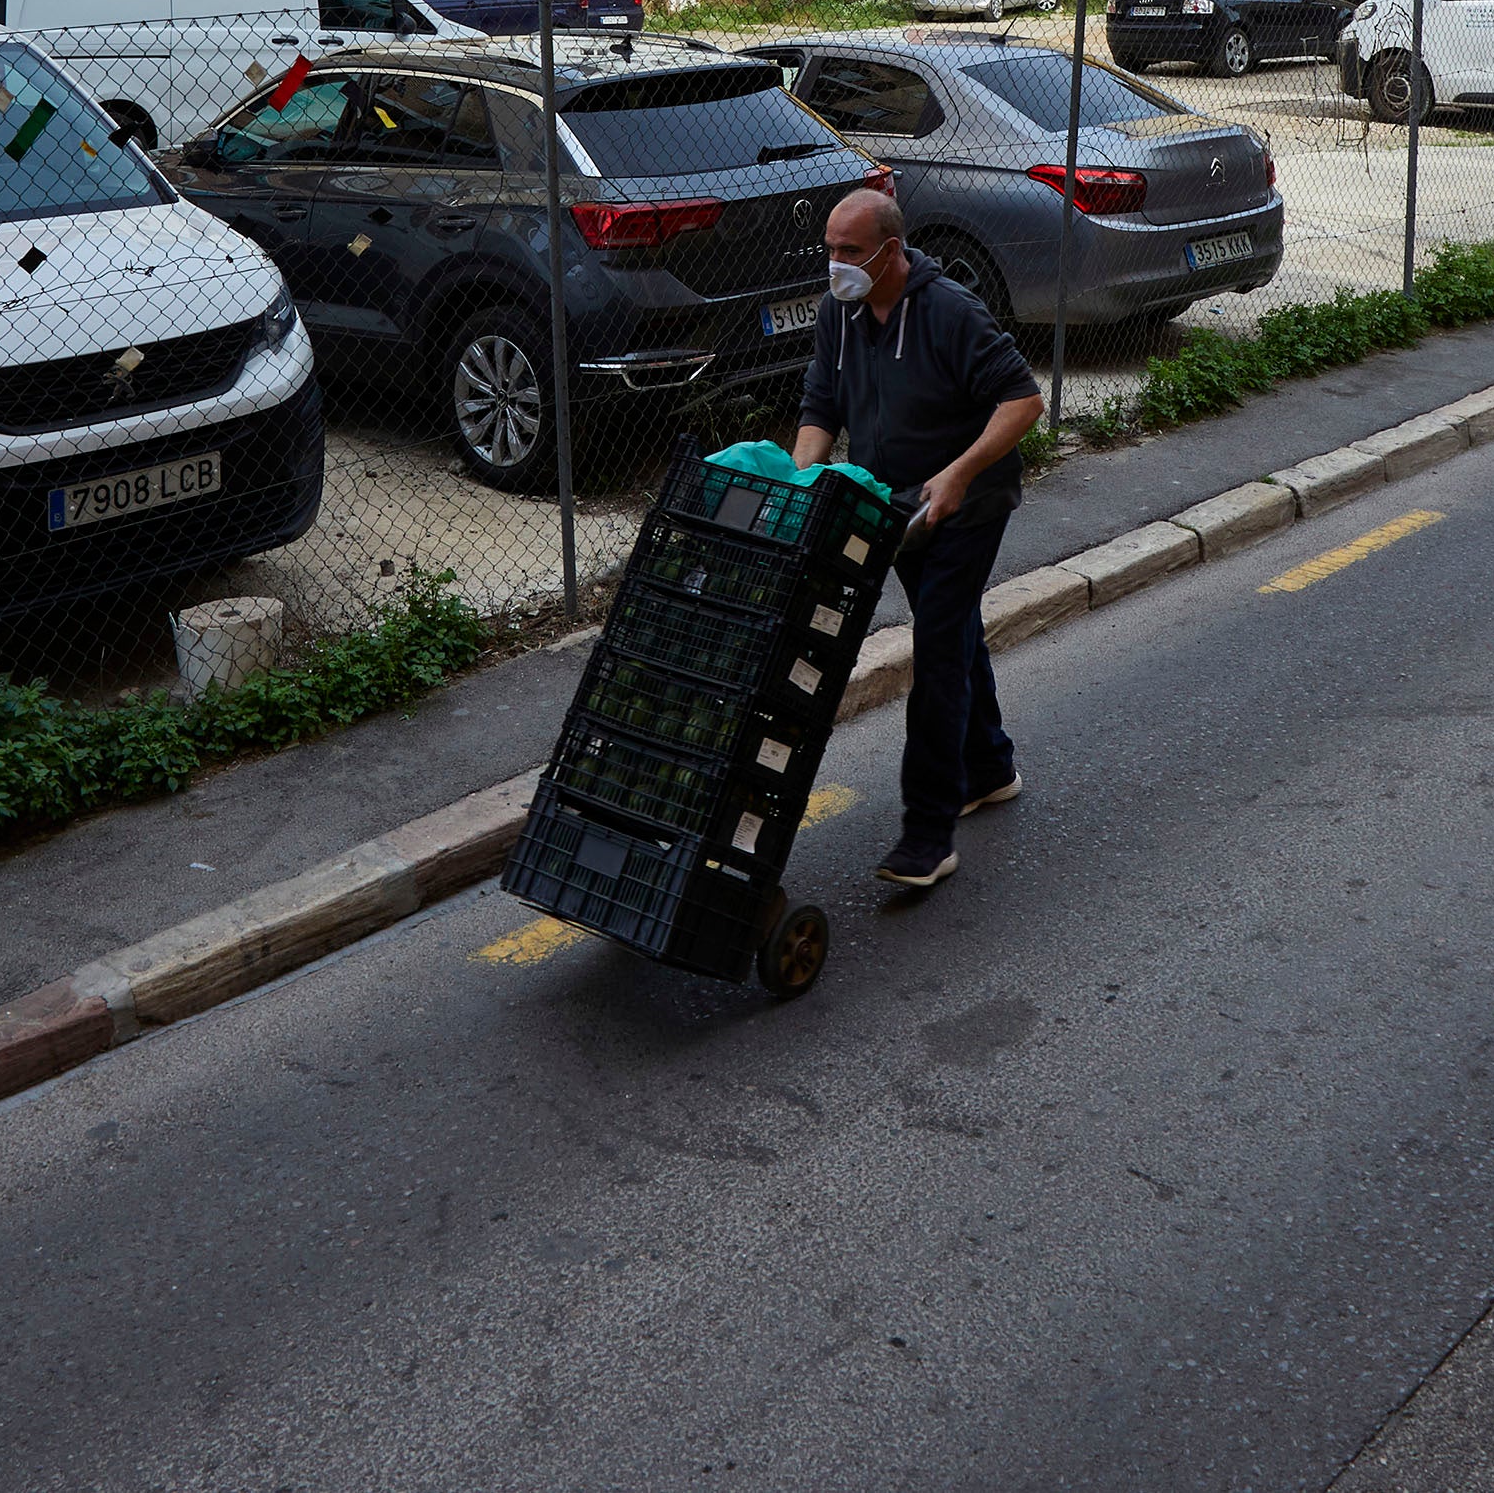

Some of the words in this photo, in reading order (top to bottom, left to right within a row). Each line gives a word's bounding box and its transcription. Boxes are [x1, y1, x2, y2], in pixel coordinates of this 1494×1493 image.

[1194, 239, 1226, 263] 3515
[1226, 235, 1251, 256] KKK
[773, 300, 817, 330] 5105
[72, 475, 150, 520] 7908
[160, 459, 213, 499] LCB
